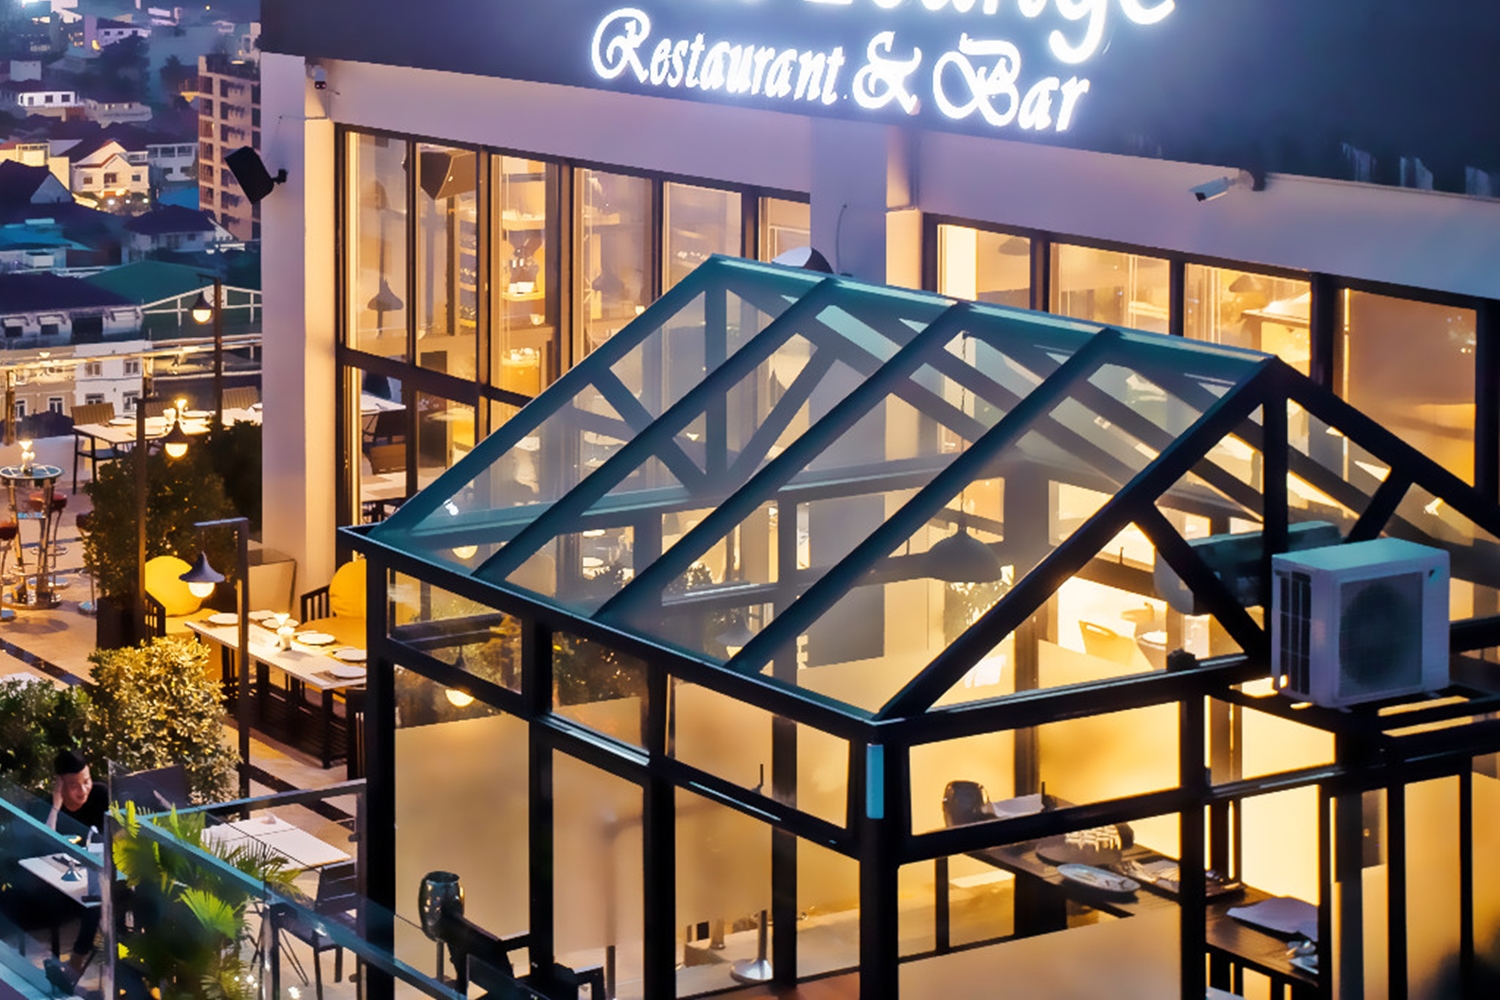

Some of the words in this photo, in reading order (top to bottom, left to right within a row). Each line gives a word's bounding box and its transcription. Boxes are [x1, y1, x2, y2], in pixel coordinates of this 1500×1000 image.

[590, 7, 846, 106] Restaurant
[851, 30, 923, 115] &
[932, 32, 1090, 133] Bar
